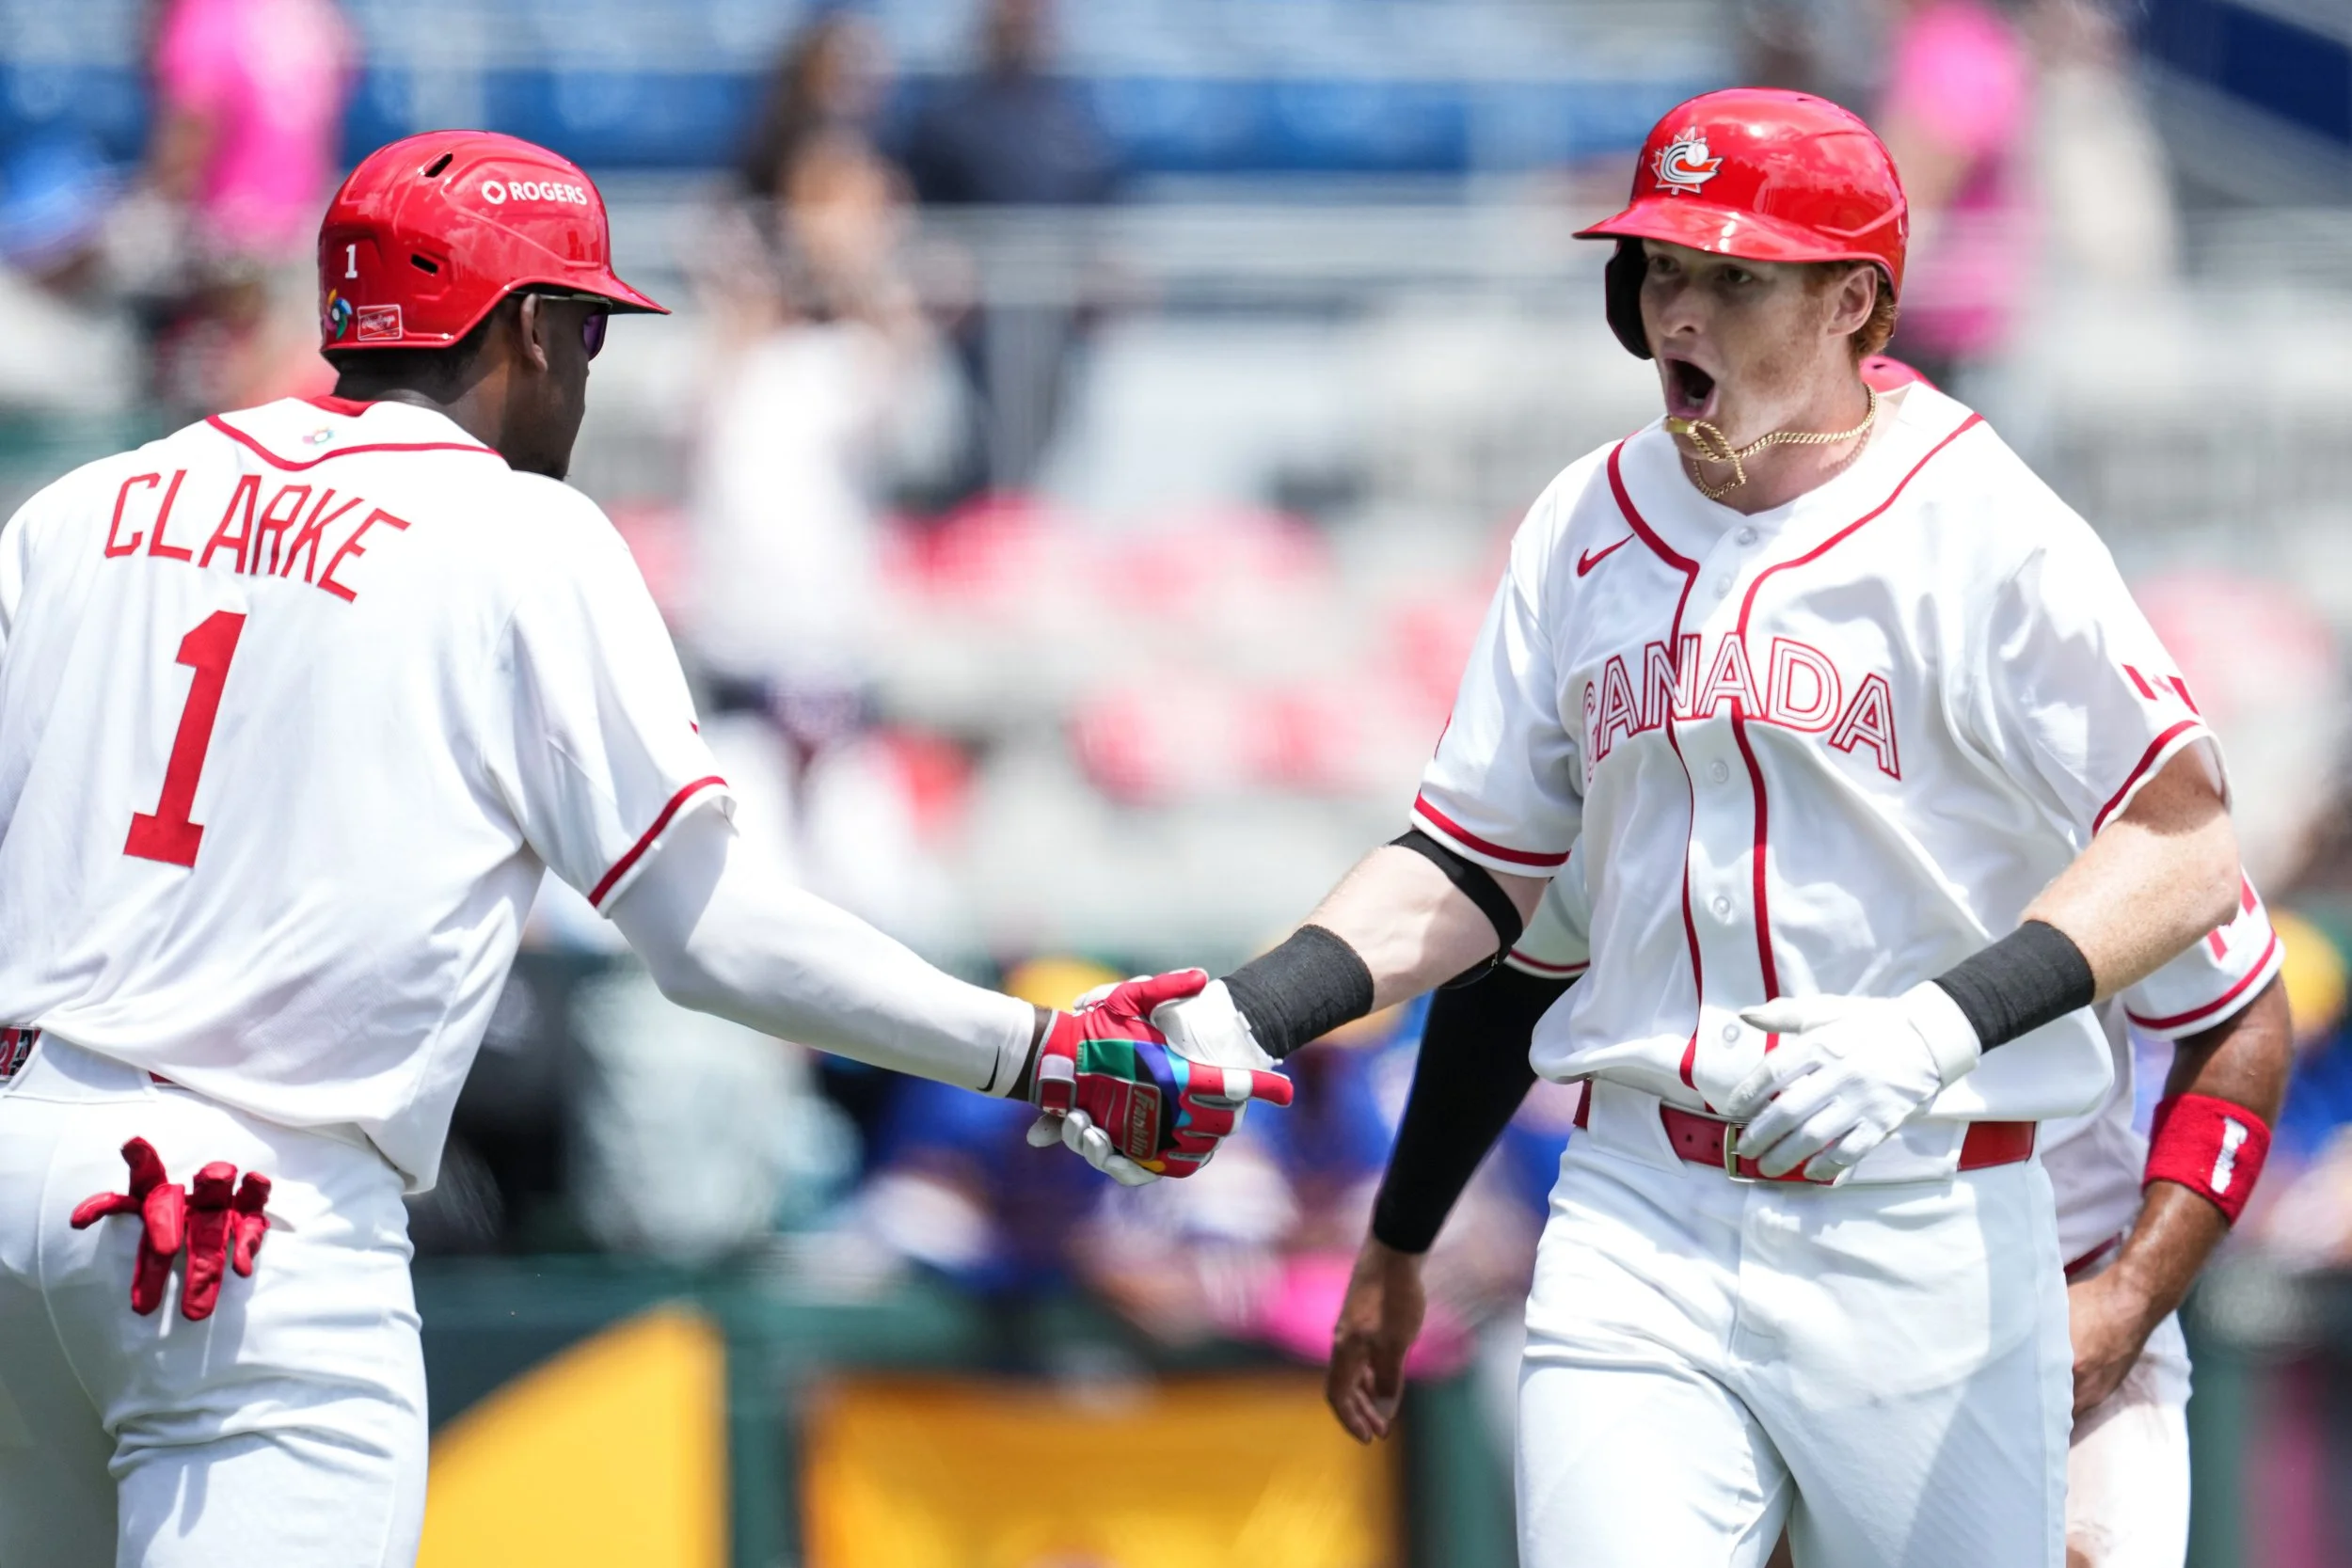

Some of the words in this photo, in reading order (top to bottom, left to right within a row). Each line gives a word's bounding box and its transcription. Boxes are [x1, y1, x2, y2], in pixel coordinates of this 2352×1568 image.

[508, 182, 587, 205] ROGERS
[345, 245, 358, 278] 1
[104, 469, 411, 603] CLARKE
[122, 610, 247, 868] 1
